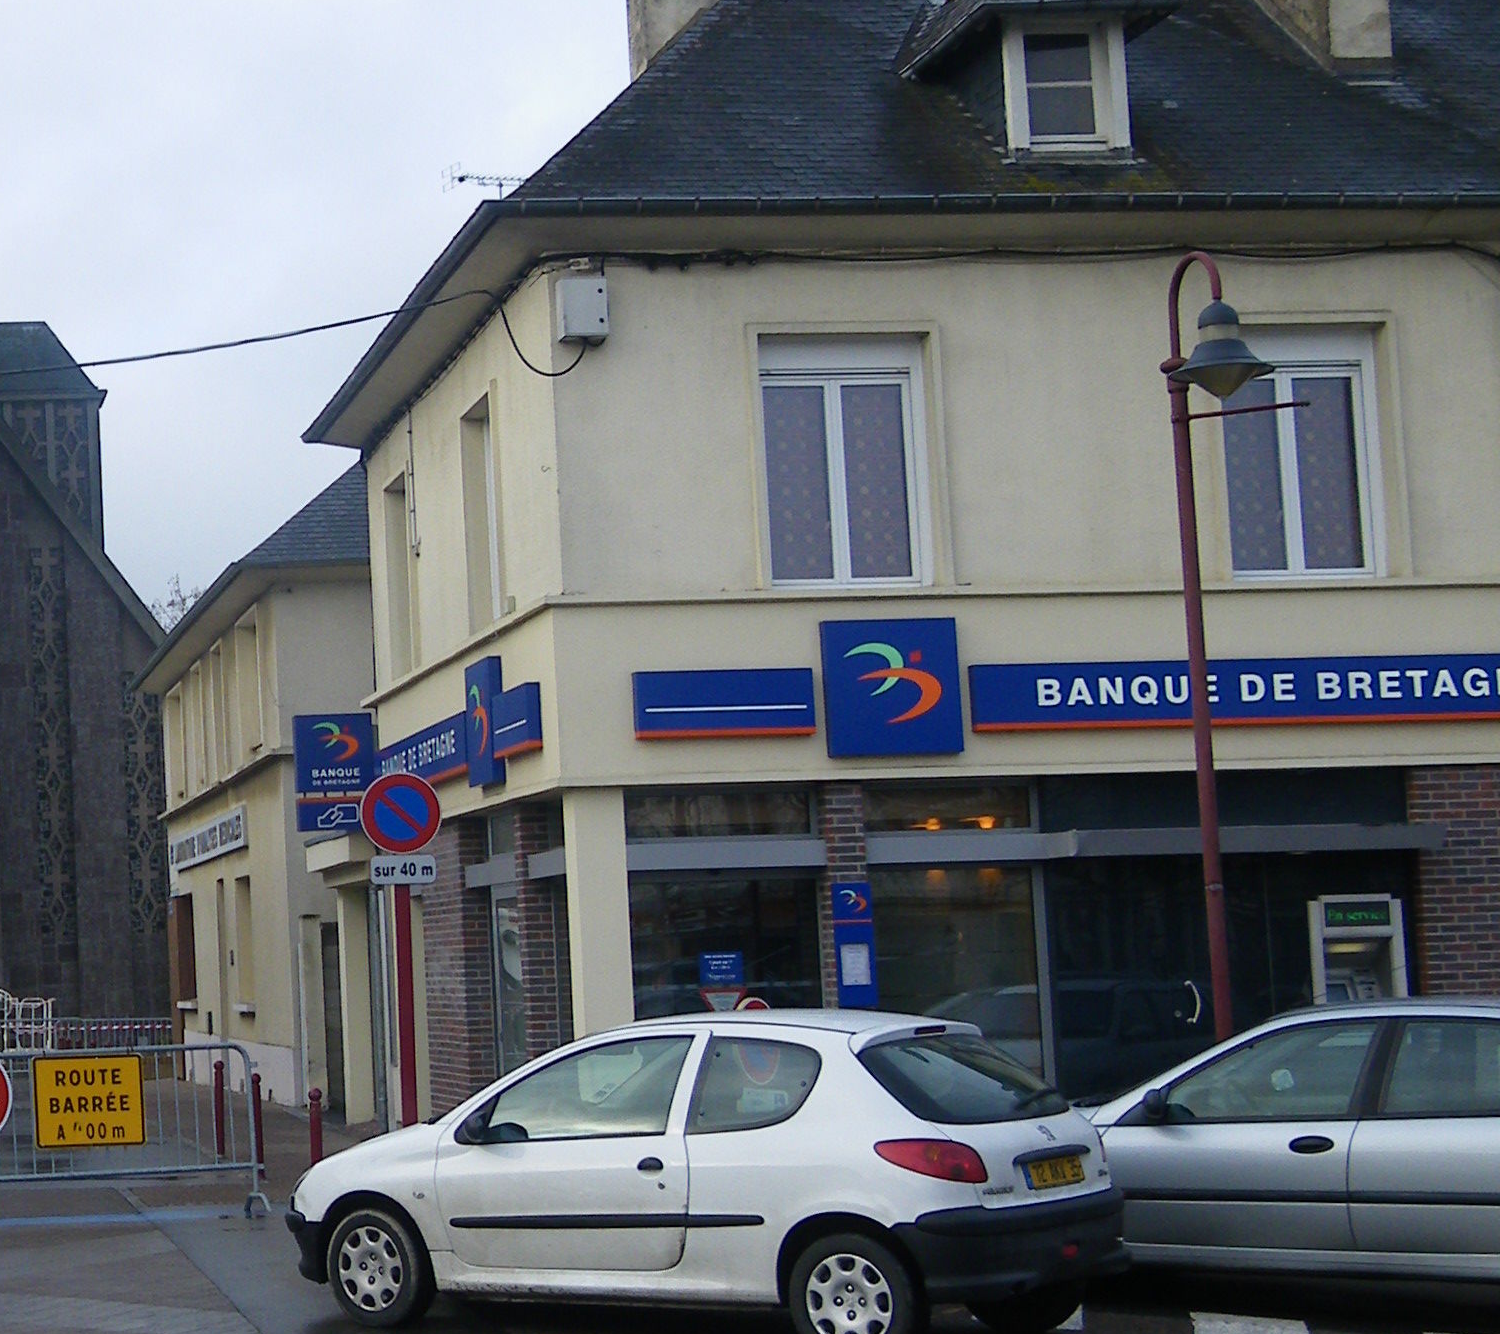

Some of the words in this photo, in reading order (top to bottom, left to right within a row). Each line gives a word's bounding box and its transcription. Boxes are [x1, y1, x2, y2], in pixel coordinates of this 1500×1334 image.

[1037, 674, 1220, 707] BANQUE
[1240, 673, 1296, 702] DE
[1316, 667, 1500, 700] BRETAG
[407, 747, 418, 770] DE
[418, 729, 456, 767] BRETAGNE
[311, 767, 361, 779] BANQUE
[374, 864, 396, 878] sur
[400, 862, 416, 877] 40
[421, 864, 433, 876] m
[54, 1068, 122, 1086] ROUTE
[49, 1091, 130, 1114] BARRÉE
[57, 1124, 66, 1140] A
[112, 1125, 125, 1139] m
